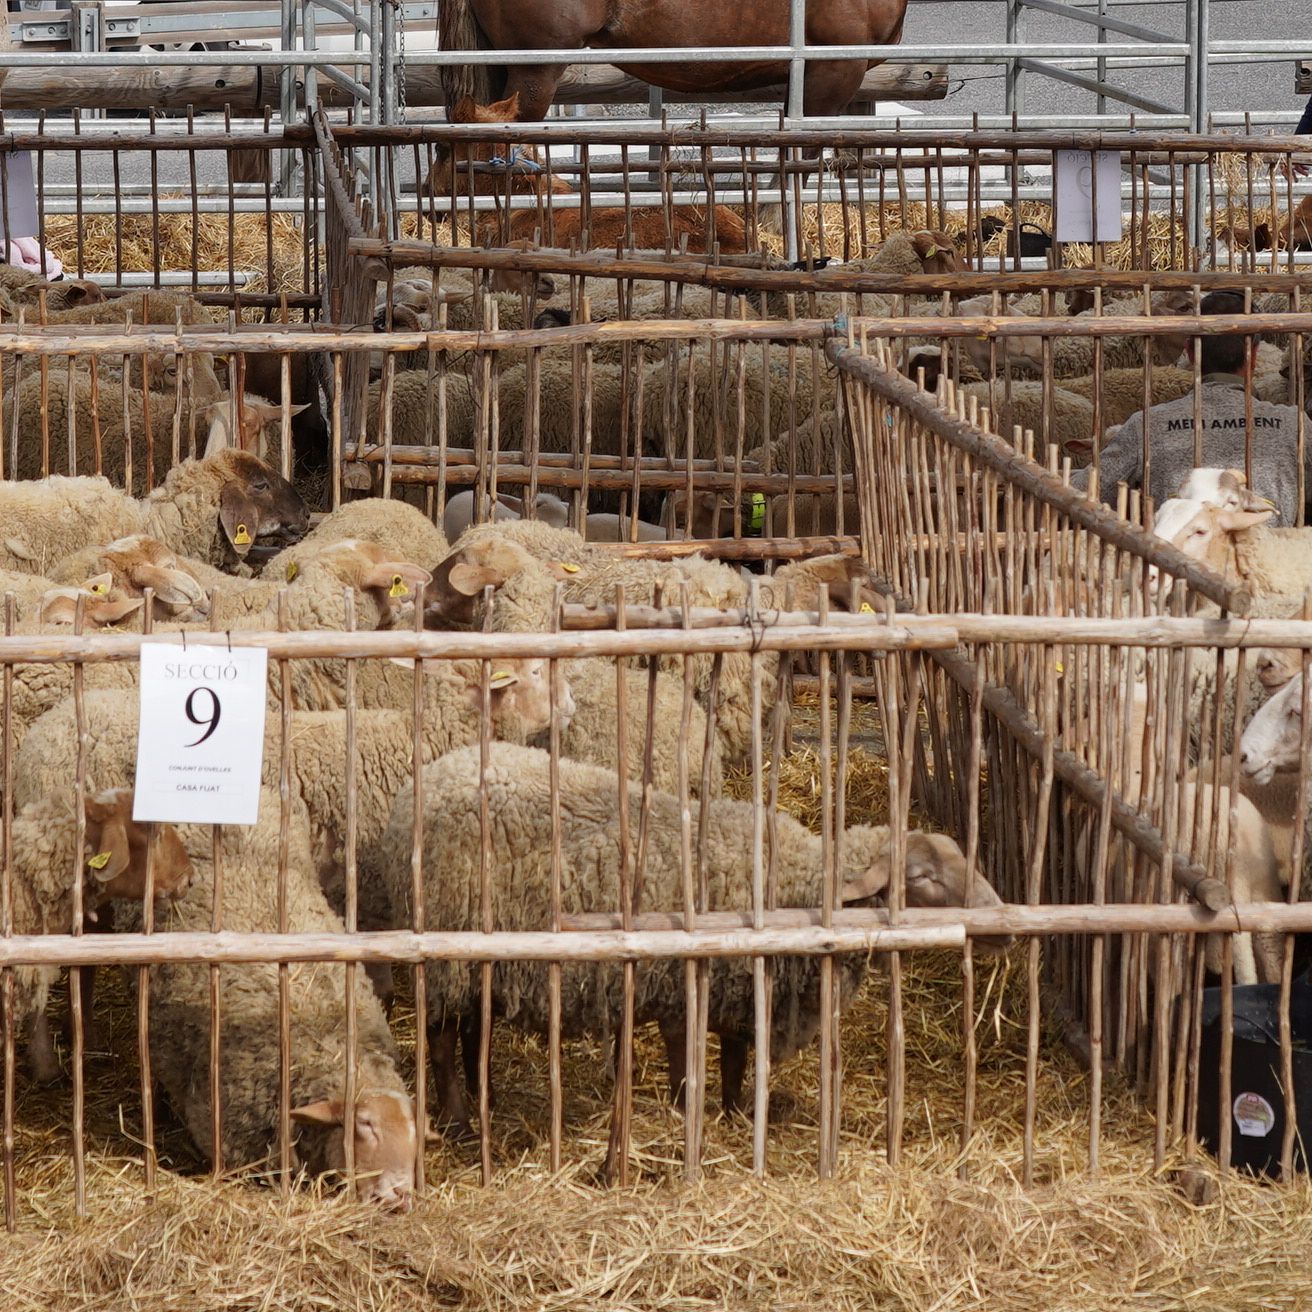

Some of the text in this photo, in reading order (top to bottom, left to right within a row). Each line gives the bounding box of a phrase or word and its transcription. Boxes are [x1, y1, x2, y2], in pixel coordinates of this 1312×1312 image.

[1211, 416, 1283, 430] AMBENT
[164, 660, 238, 681] SECCIÓ
[183, 686, 221, 748] 9
[176, 784, 198, 792] CASA
